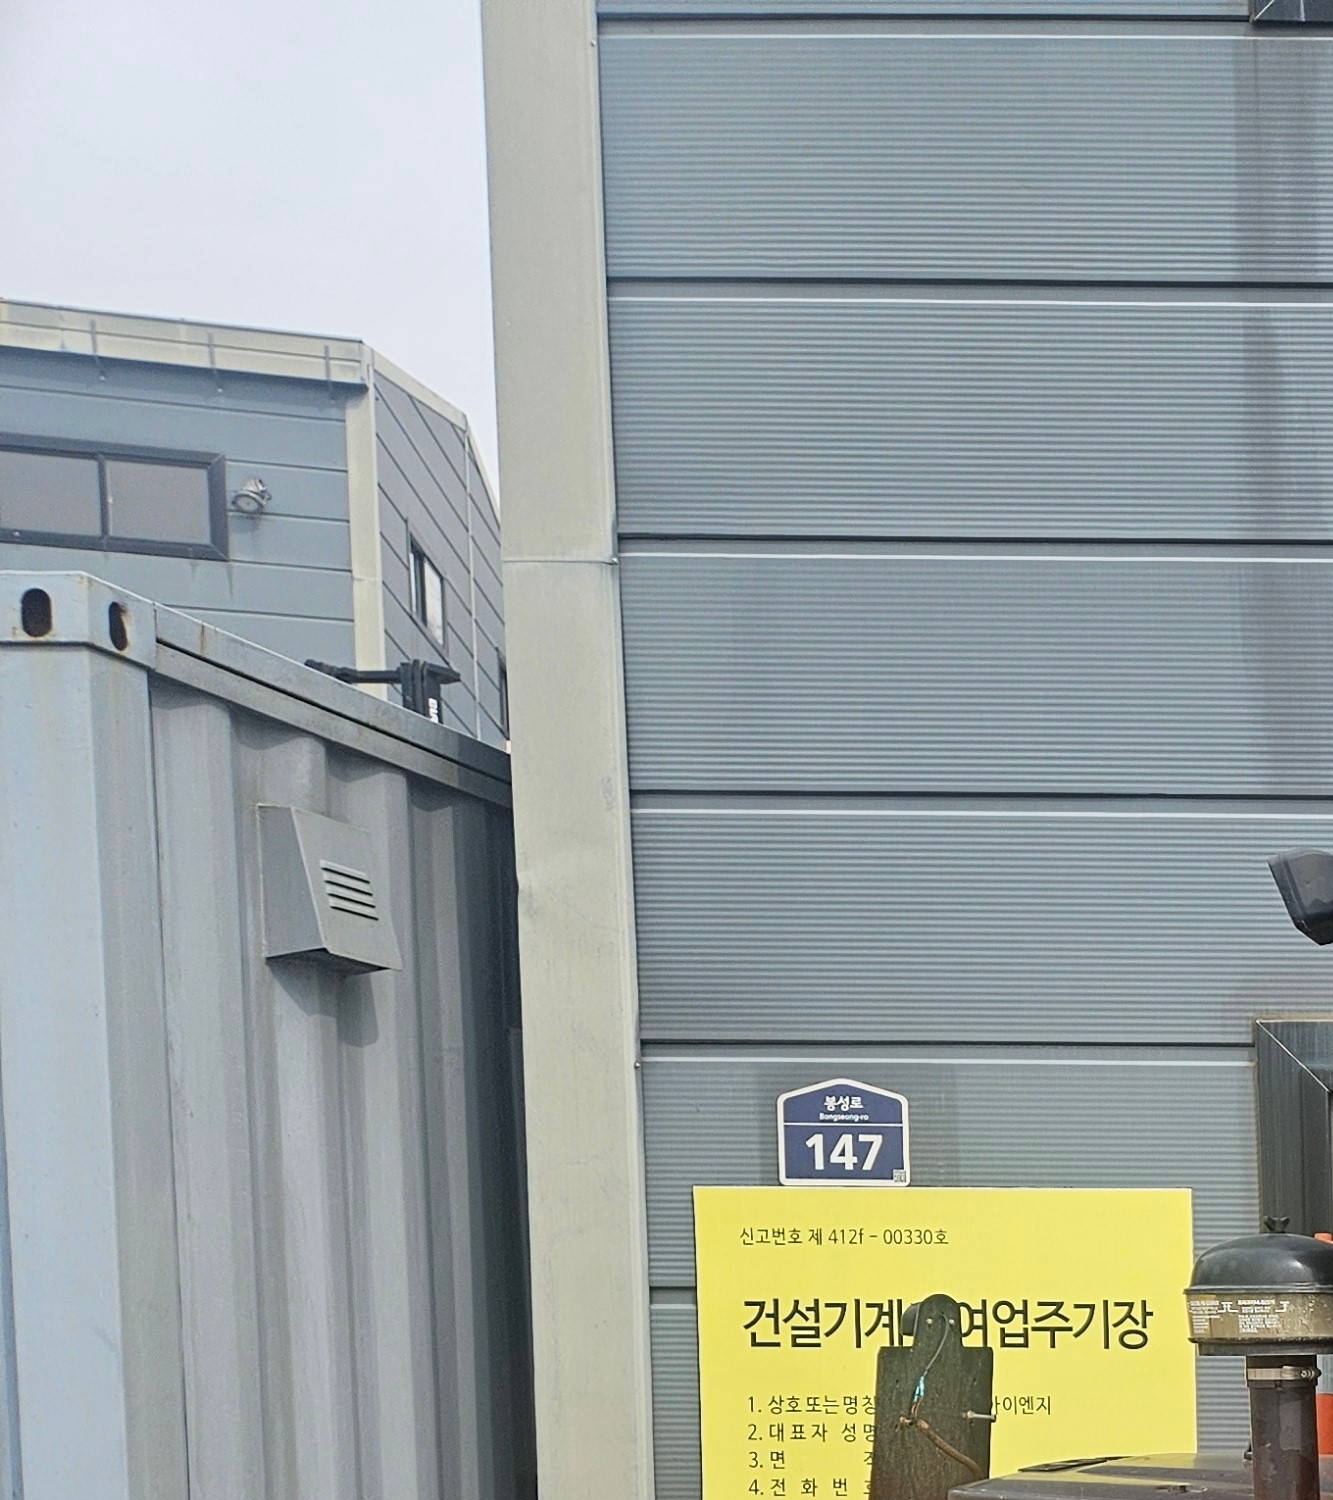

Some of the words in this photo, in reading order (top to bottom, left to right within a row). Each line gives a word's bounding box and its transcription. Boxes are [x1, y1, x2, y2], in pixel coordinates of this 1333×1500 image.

[823, 1095, 864, 1112] 봉성로
[819, 1112, 870, 1122] Bongseong-ro
[805, 1133, 883, 1171] 147
[739, 1227, 803, 1246] 신고번호
[808, 1227, 823, 1246] 제
[883, 1228, 949, 1246] 00330호
[742, 1297, 1154, 1350] 건설기계여업주기장
[747, 1395, 762, 1413] 1.
[767, 1394, 803, 1415] 상호
[805, 1394, 840, 1415] 또는
[992, 1395, 1051, 1416] 이엔지
[747, 1423, 763, 1441] 2.
[769, 1422, 828, 1443] 대표자
[748, 1451, 764, 1469] 3.
[748, 1478, 764, 1496] 4.
